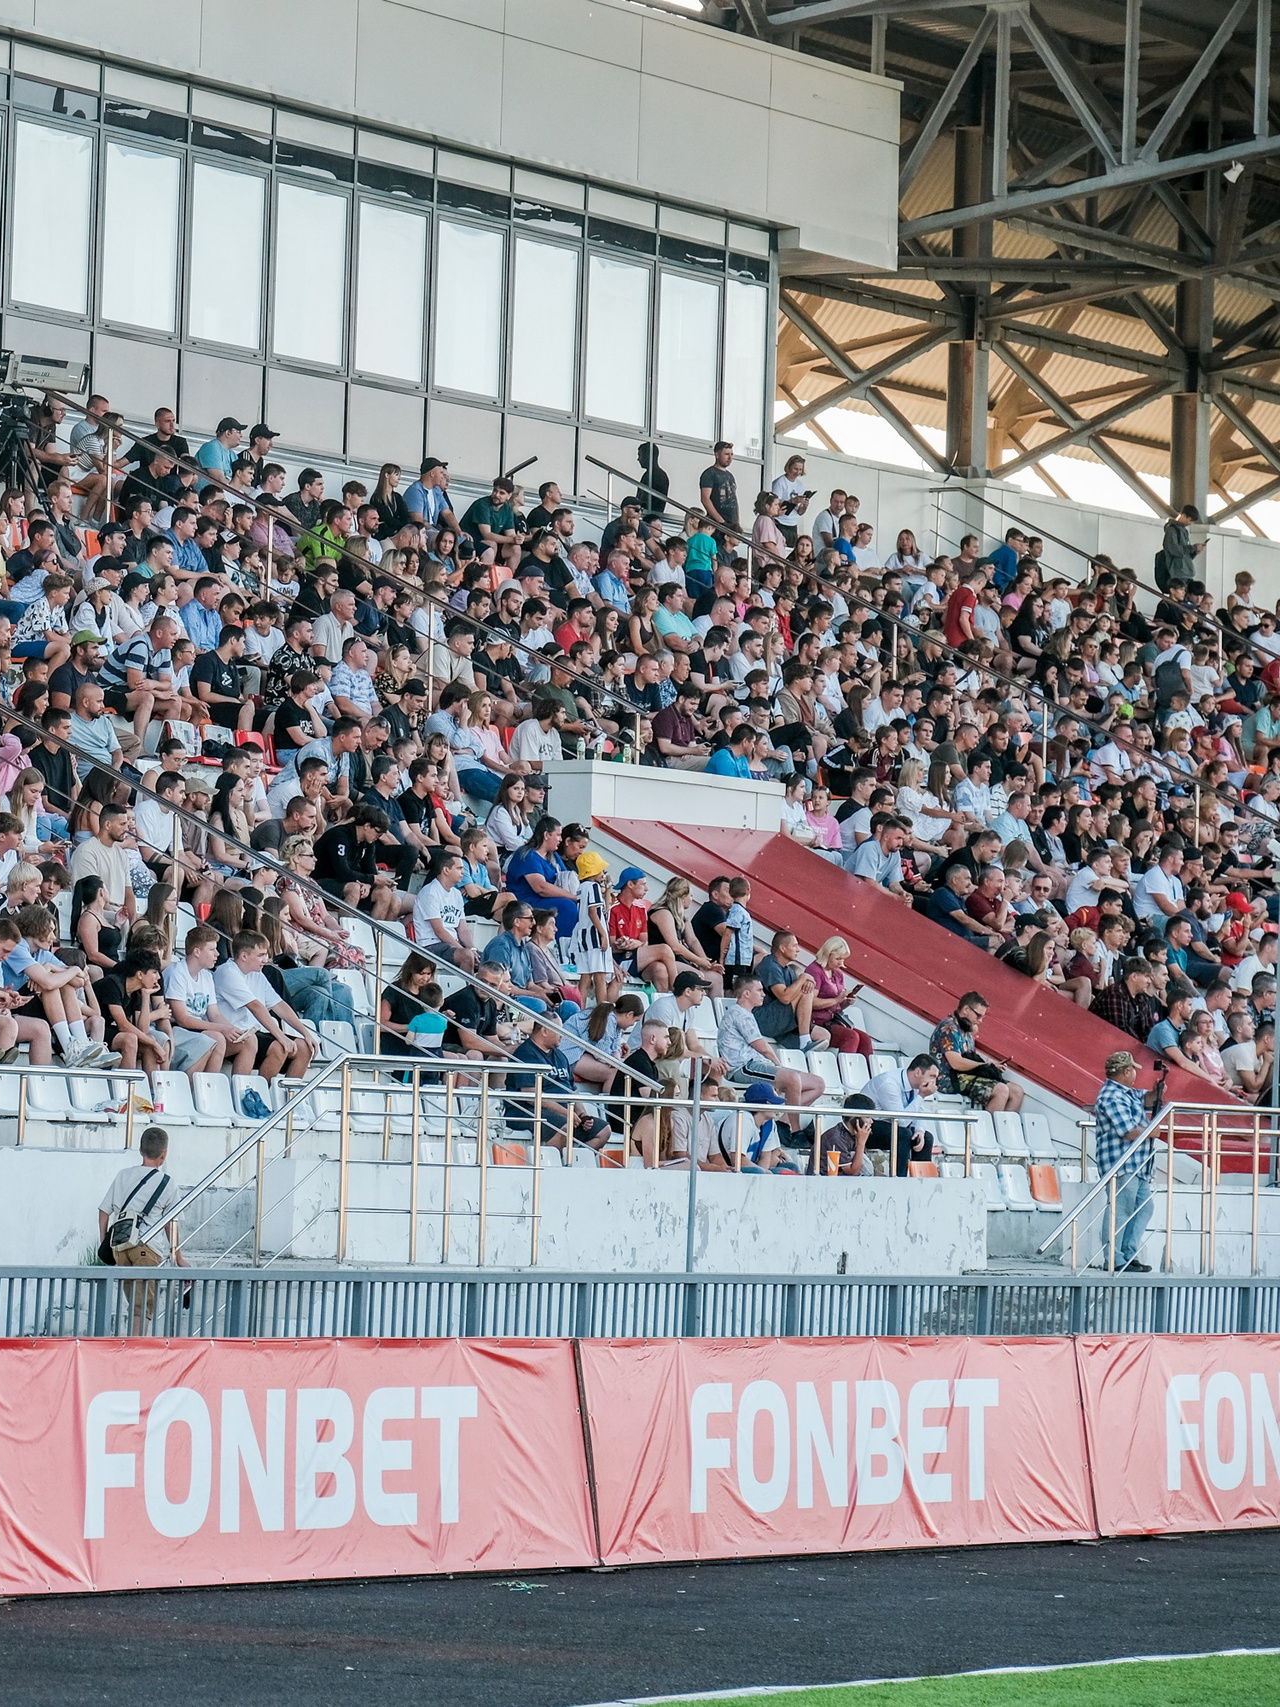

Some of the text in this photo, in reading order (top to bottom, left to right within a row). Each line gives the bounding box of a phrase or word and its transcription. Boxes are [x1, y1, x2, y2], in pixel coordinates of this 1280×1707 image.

[337, 844, 346, 856] 3
[83, 1386, 478, 1539] FONBET
[690, 1378, 999, 1513] FONBET
